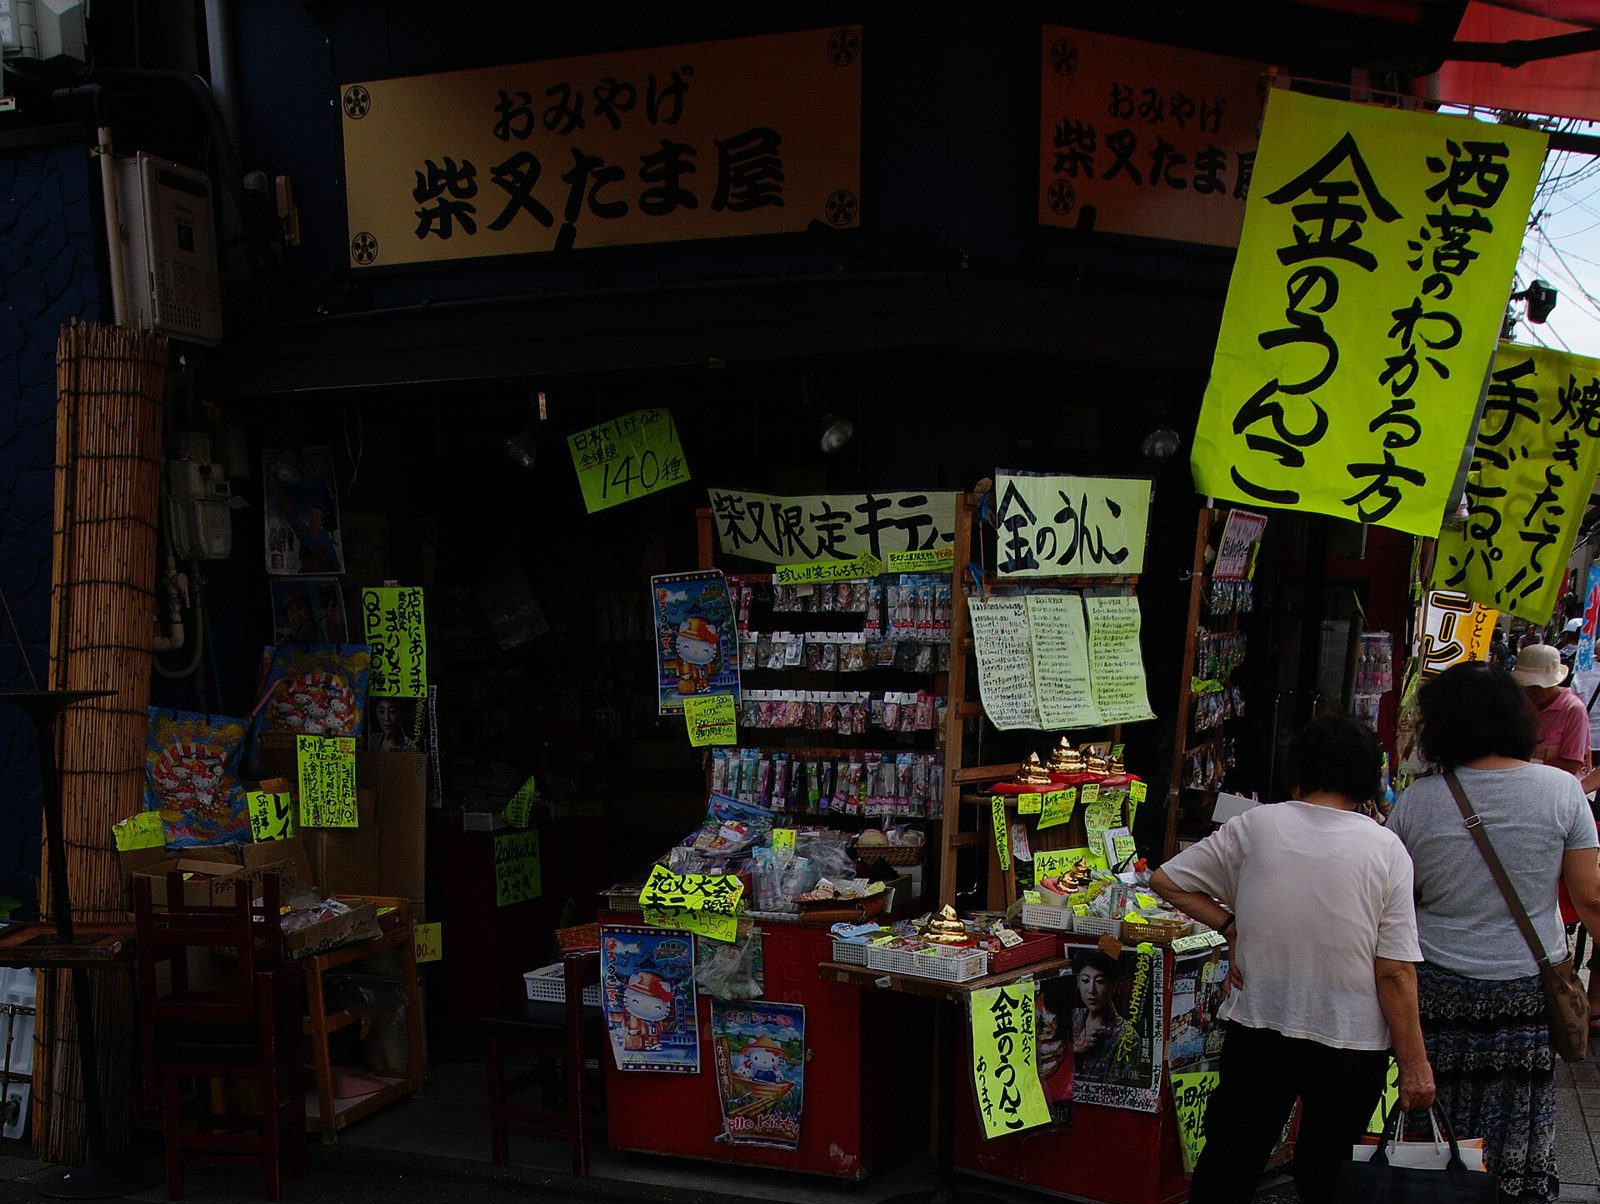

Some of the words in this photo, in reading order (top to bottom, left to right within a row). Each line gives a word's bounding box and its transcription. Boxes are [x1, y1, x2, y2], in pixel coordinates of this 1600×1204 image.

[493, 64, 694, 141] おみやげ
[1107, 80, 1227, 135] おみやげ
[413, 125, 786, 240] 柴又たま屋
[1230, 132, 1402, 505] 金のうんこ
[998, 478, 1129, 573] 金のうんこ
[648, 872, 737, 898] 花火大会
[990, 988, 1024, 1129] 金のうんこ
[728, 1116, 756, 1131] ello
